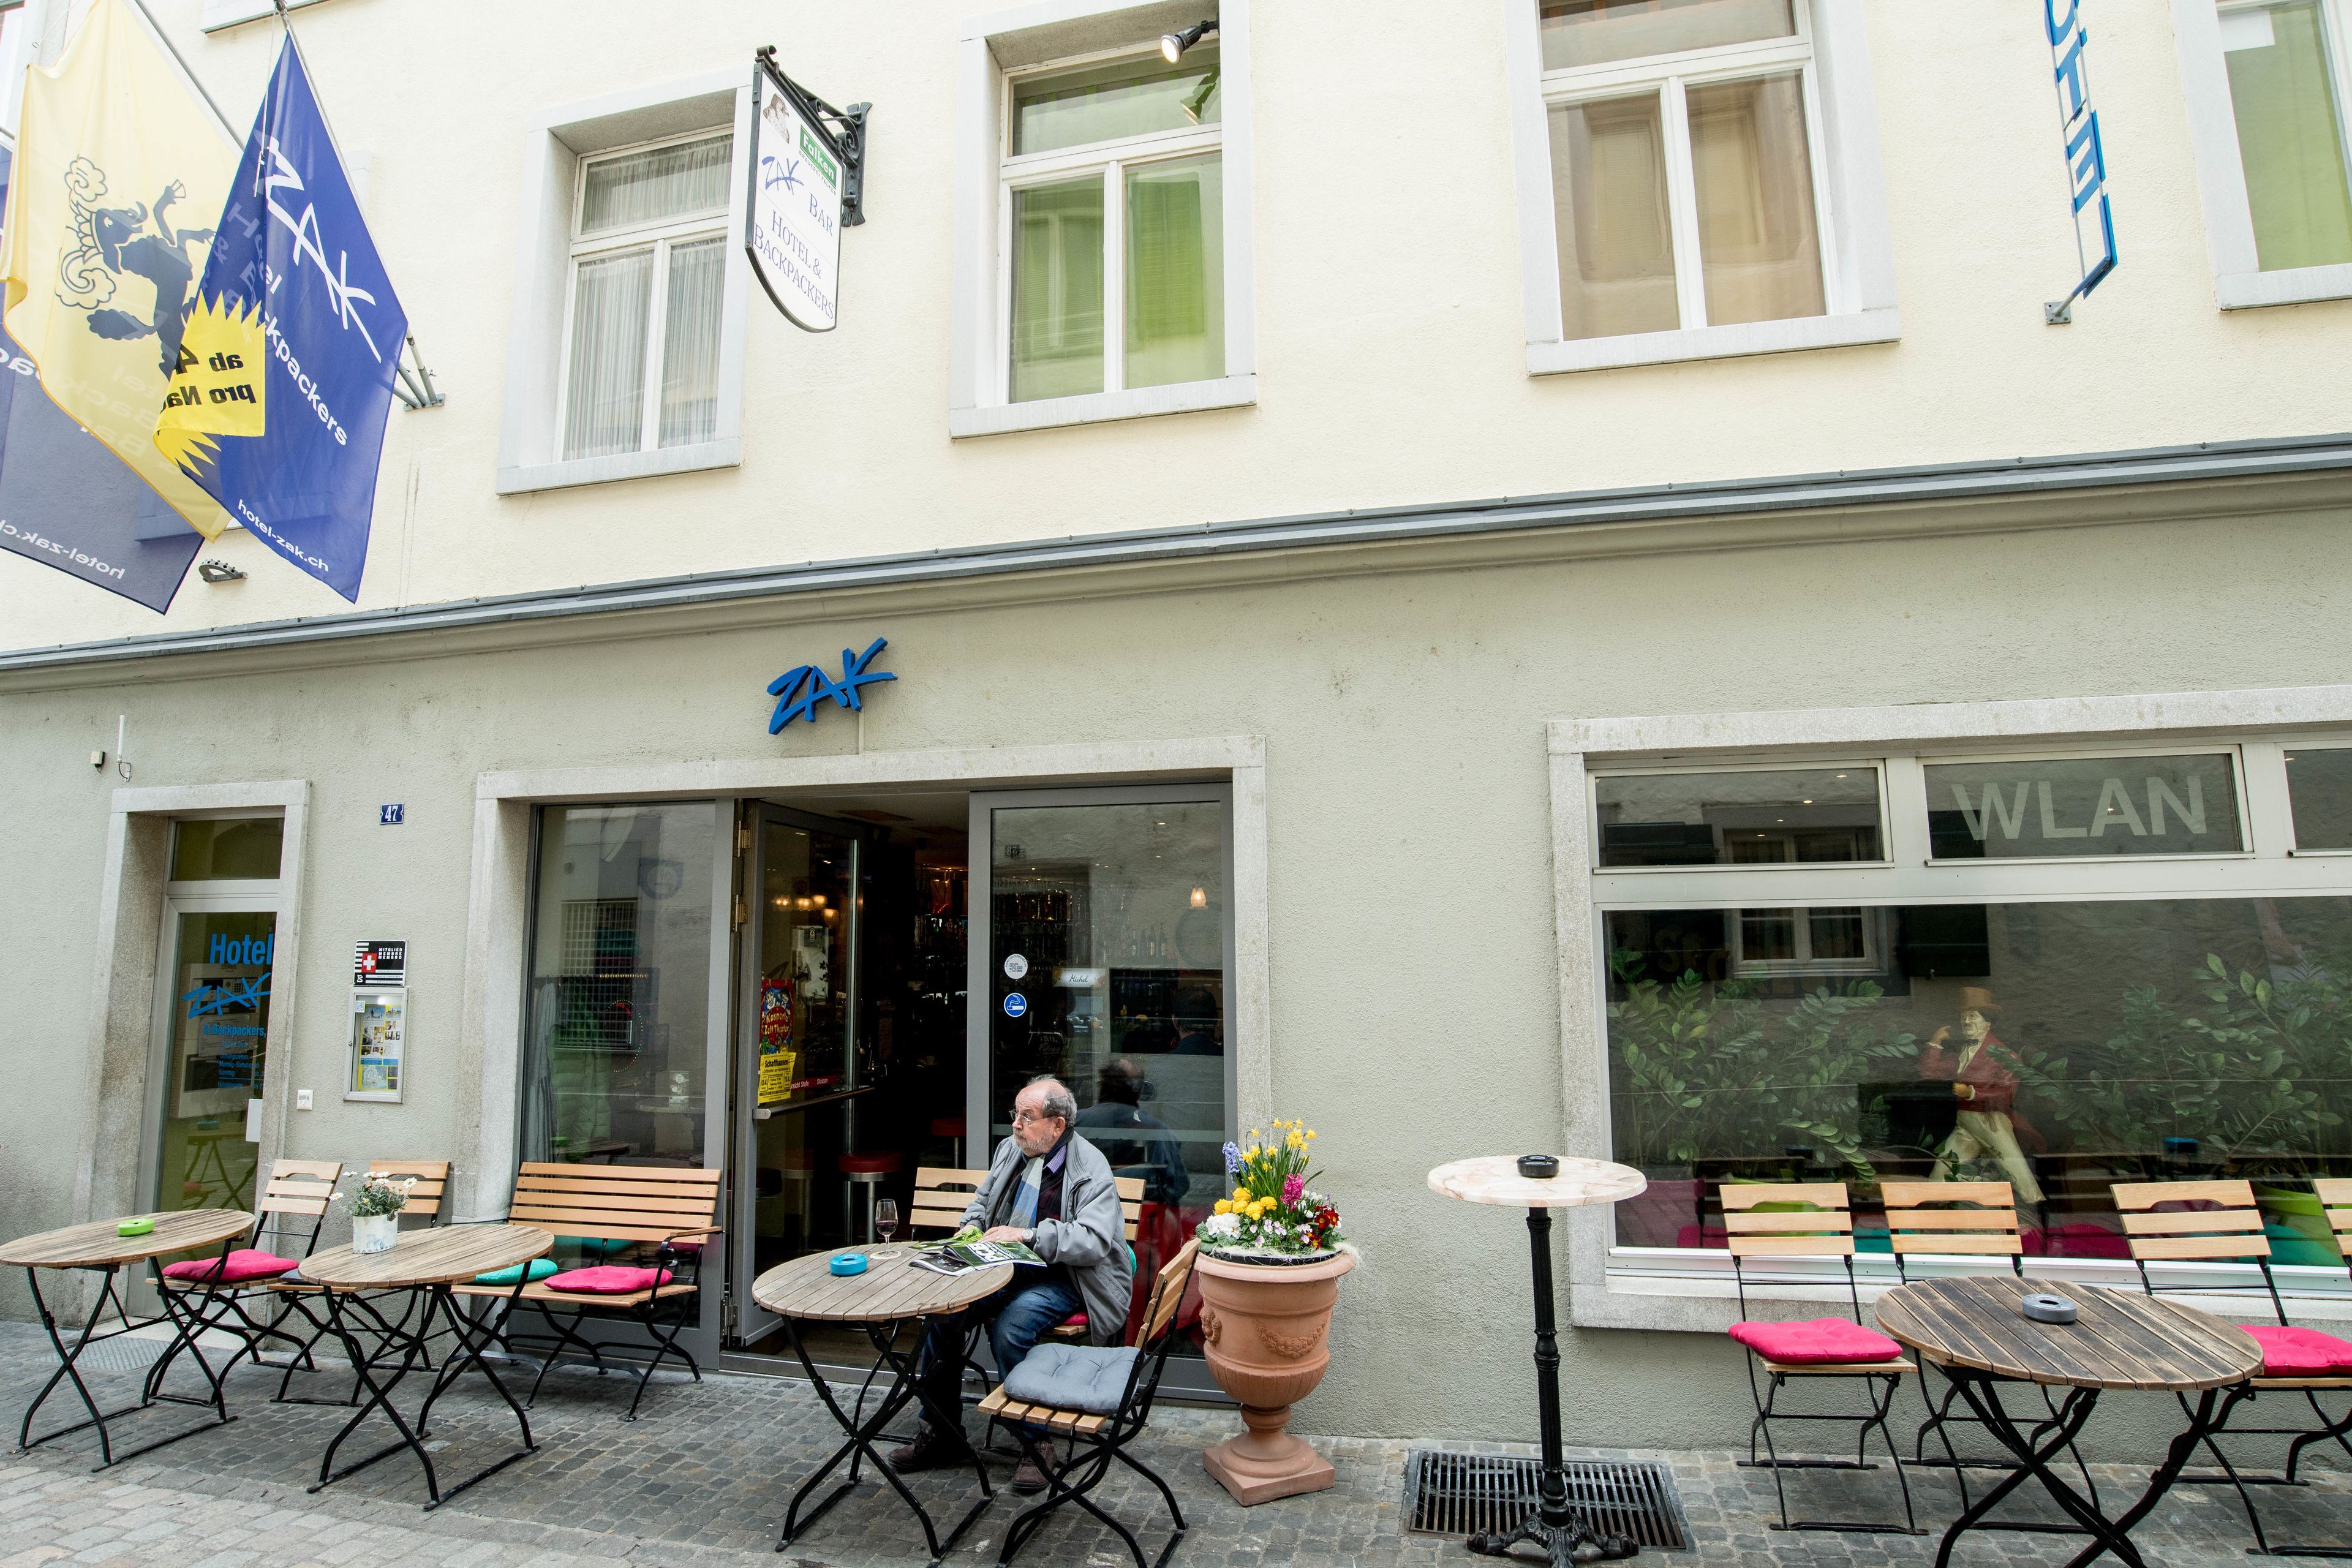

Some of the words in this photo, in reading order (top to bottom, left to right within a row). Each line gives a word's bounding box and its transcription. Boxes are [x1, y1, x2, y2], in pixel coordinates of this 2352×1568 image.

[761, 156, 804, 195] ZAK
[799, 149, 821, 178] BRAUEREI
[821, 176, 837, 196] FALKEN
[803, 132, 834, 180] Falken
[809, 192, 833, 237] BAR
[265, 137, 381, 363] ZAK
[771, 209, 811, 268] HOTEL
[813, 258, 821, 279] &
[754, 222, 834, 320] BACKPACKERS
[238, 499, 329, 572] hotel-zak.ch
[766, 636, 899, 736] ZAK
[385, 805, 399, 822] 47
[1951, 775, 2207, 841] WLAN
[209, 933, 274, 965] Hotel
[181, 972, 272, 1019] ZAK
[1068, 973, 1089, 983] Michel
[766, 1012, 789, 1024] Kasperle
[764, 1058, 789, 1068] Schaffhausen
